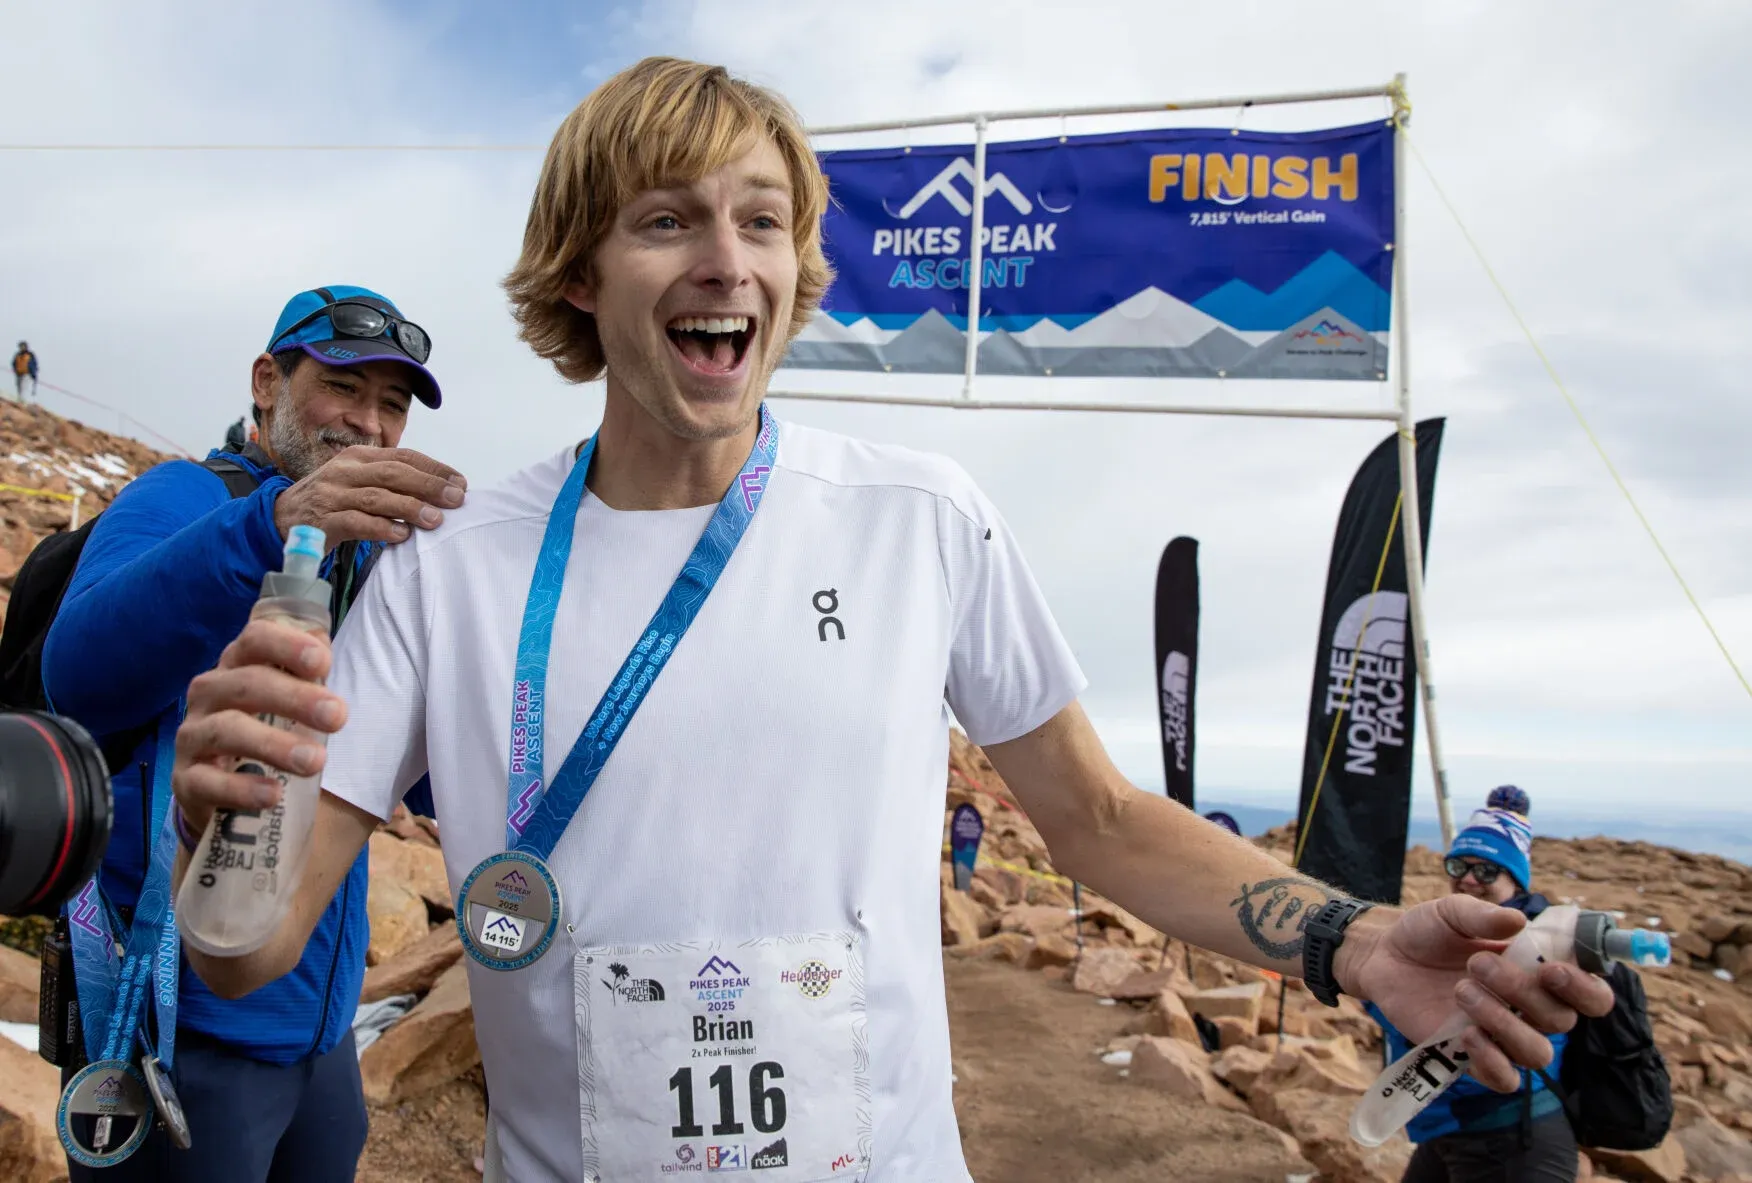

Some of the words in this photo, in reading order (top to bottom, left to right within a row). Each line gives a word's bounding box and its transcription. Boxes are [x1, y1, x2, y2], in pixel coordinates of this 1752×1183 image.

[1149, 153, 1359, 203] FINISH
[1234, 209, 1289, 224] Vertical
[1291, 209, 1327, 223] Gain
[873, 226, 962, 257] PIKES
[585, 700, 615, 739] Where
[607, 653, 644, 702] Legends
[636, 629, 659, 655] Rise
[602, 714, 625, 741] New
[619, 664, 656, 715] Journeys
[649, 633, 676, 666] Begin
[1324, 648, 1356, 716] THE
[514, 680, 530, 723] PEAK
[1376, 656, 1406, 747] FACE
[1344, 650, 1381, 777] NORTH
[526, 688, 543, 764] ASCENT
[512, 725, 527, 774] PIKES
[498, 900, 520, 912] 2025
[484, 931, 497, 943] 14
[631, 978, 649, 987] THE
[689, 979, 719, 990] PIKES
[722, 976, 750, 988] PEAK
[781, 967, 843, 984] Heuberger
[618, 986, 649, 996] NORTH
[627, 994, 649, 1003] FACE
[698, 989, 744, 1001] ASCENT
[707, 1001, 735, 1012] 2025
[692, 1013, 754, 1042] Brian
[691, 1048, 702, 1058] 2x
[703, 1047, 722, 1058] Peak
[668, 1061, 787, 1138] 116
[661, 1160, 702, 1174] tailwind
[755, 1152, 785, 1167] näak
